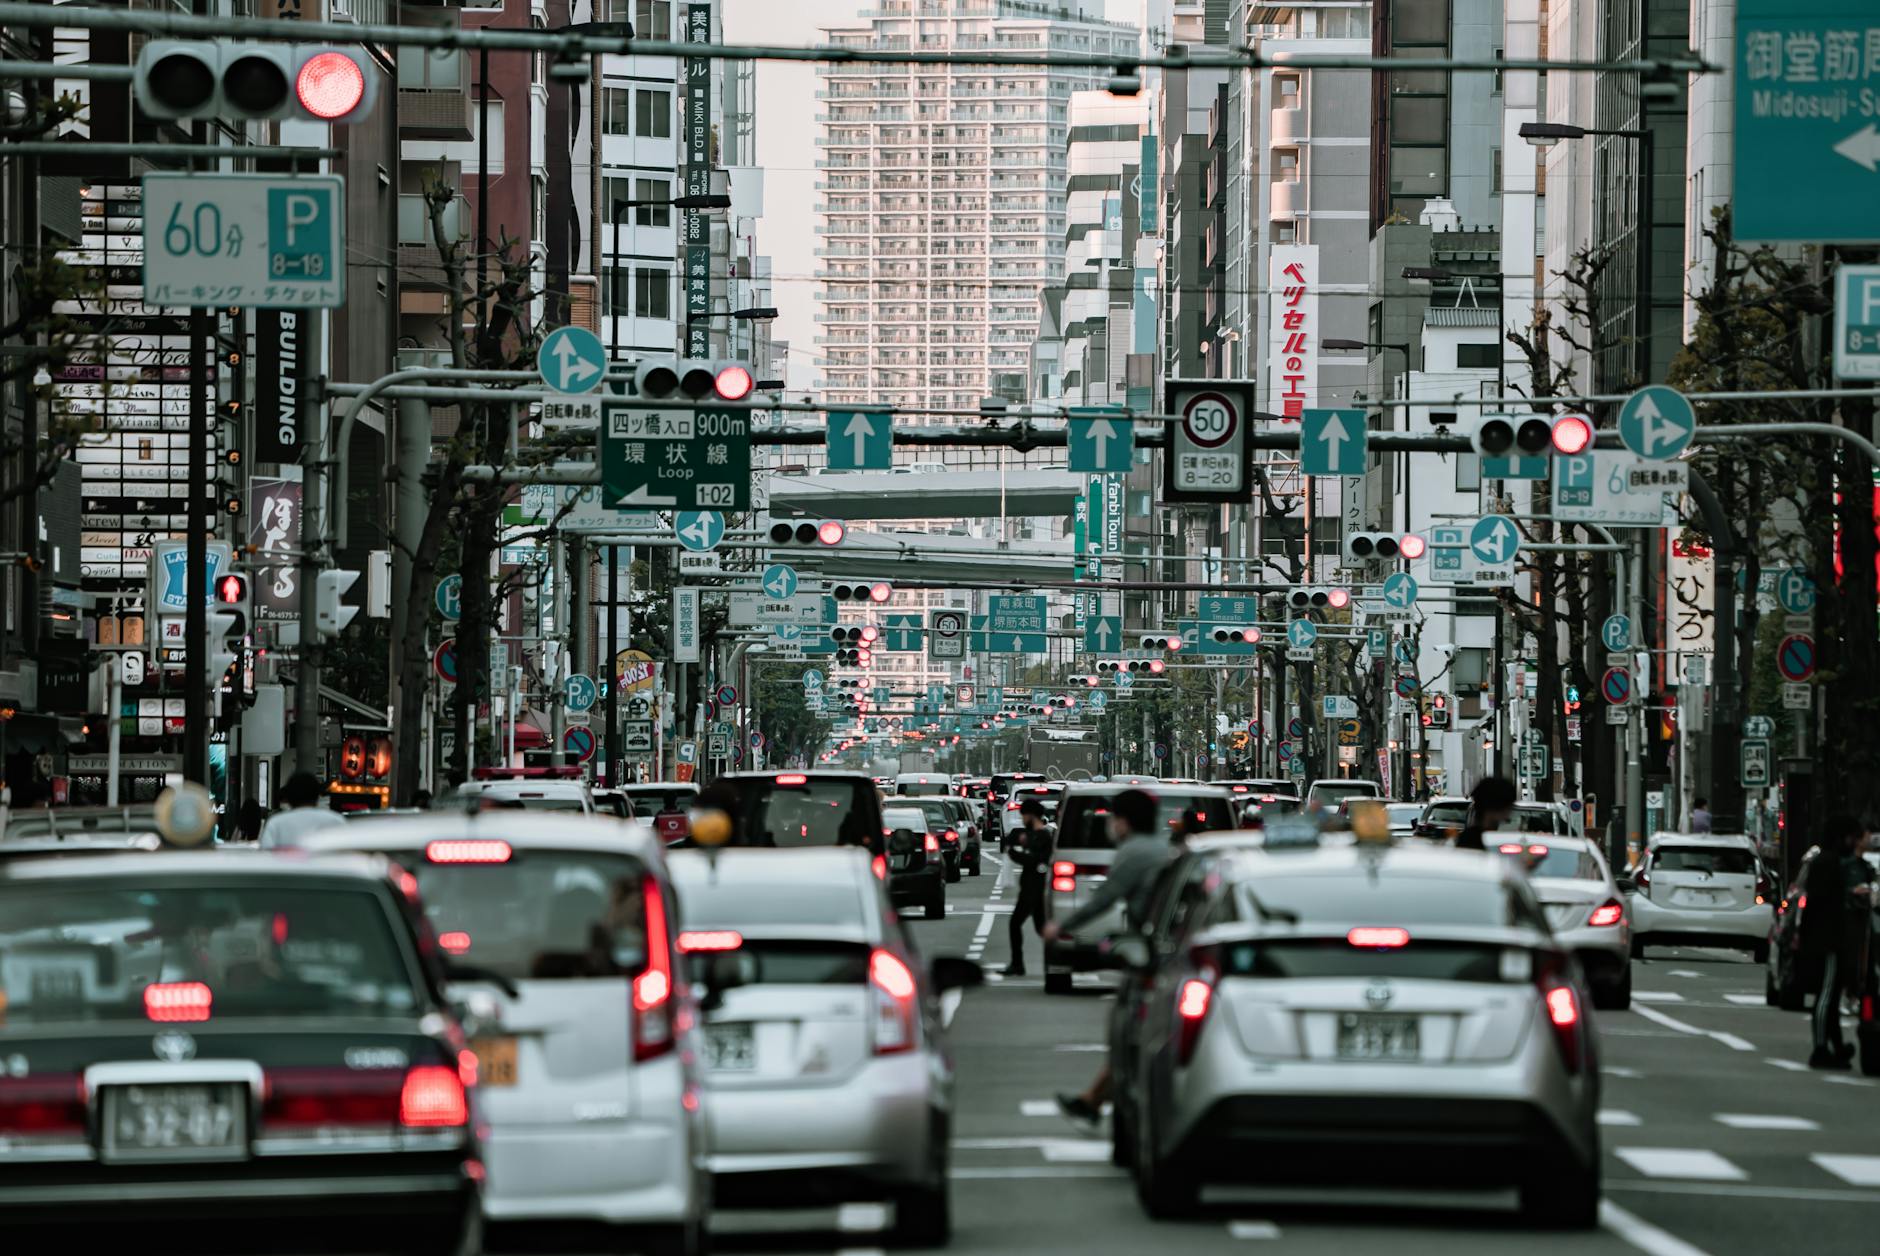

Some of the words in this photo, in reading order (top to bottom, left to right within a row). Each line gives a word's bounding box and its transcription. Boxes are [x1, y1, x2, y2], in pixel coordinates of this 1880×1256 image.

[690, 11, 707, 77] 美貴ル
[694, 101, 704, 124] MIKI
[1752, 88, 1880, 122] Midosuji-S
[163, 200, 244, 258] 60分
[286, 194, 319, 247] P
[272, 252, 323, 276] 8-19
[229, 353, 240, 365] 8
[278, 311, 297, 446] BUILDING
[229, 402, 240, 414] 7
[613, 413, 690, 435] 四ツ橋入口
[697, 413, 745, 436] 900m
[1194, 408, 1225, 432] 50
[623, 442, 729, 465] 環状線
[657, 466, 694, 480] Loop
[1185, 471, 1233, 484] 8-20
[1568, 457, 1588, 486] P
[698, 485, 731, 504] 1-02
[1108, 517, 1120, 551] Town
[1787, 577, 1803, 606] P
[1210, 601, 1245, 614] 今里
[941, 619, 955, 631] 50
[1609, 623, 1621, 646] P
[1372, 631, 1384, 646] P
[568, 683, 582, 707] P
[1327, 698, 1335, 707] P
